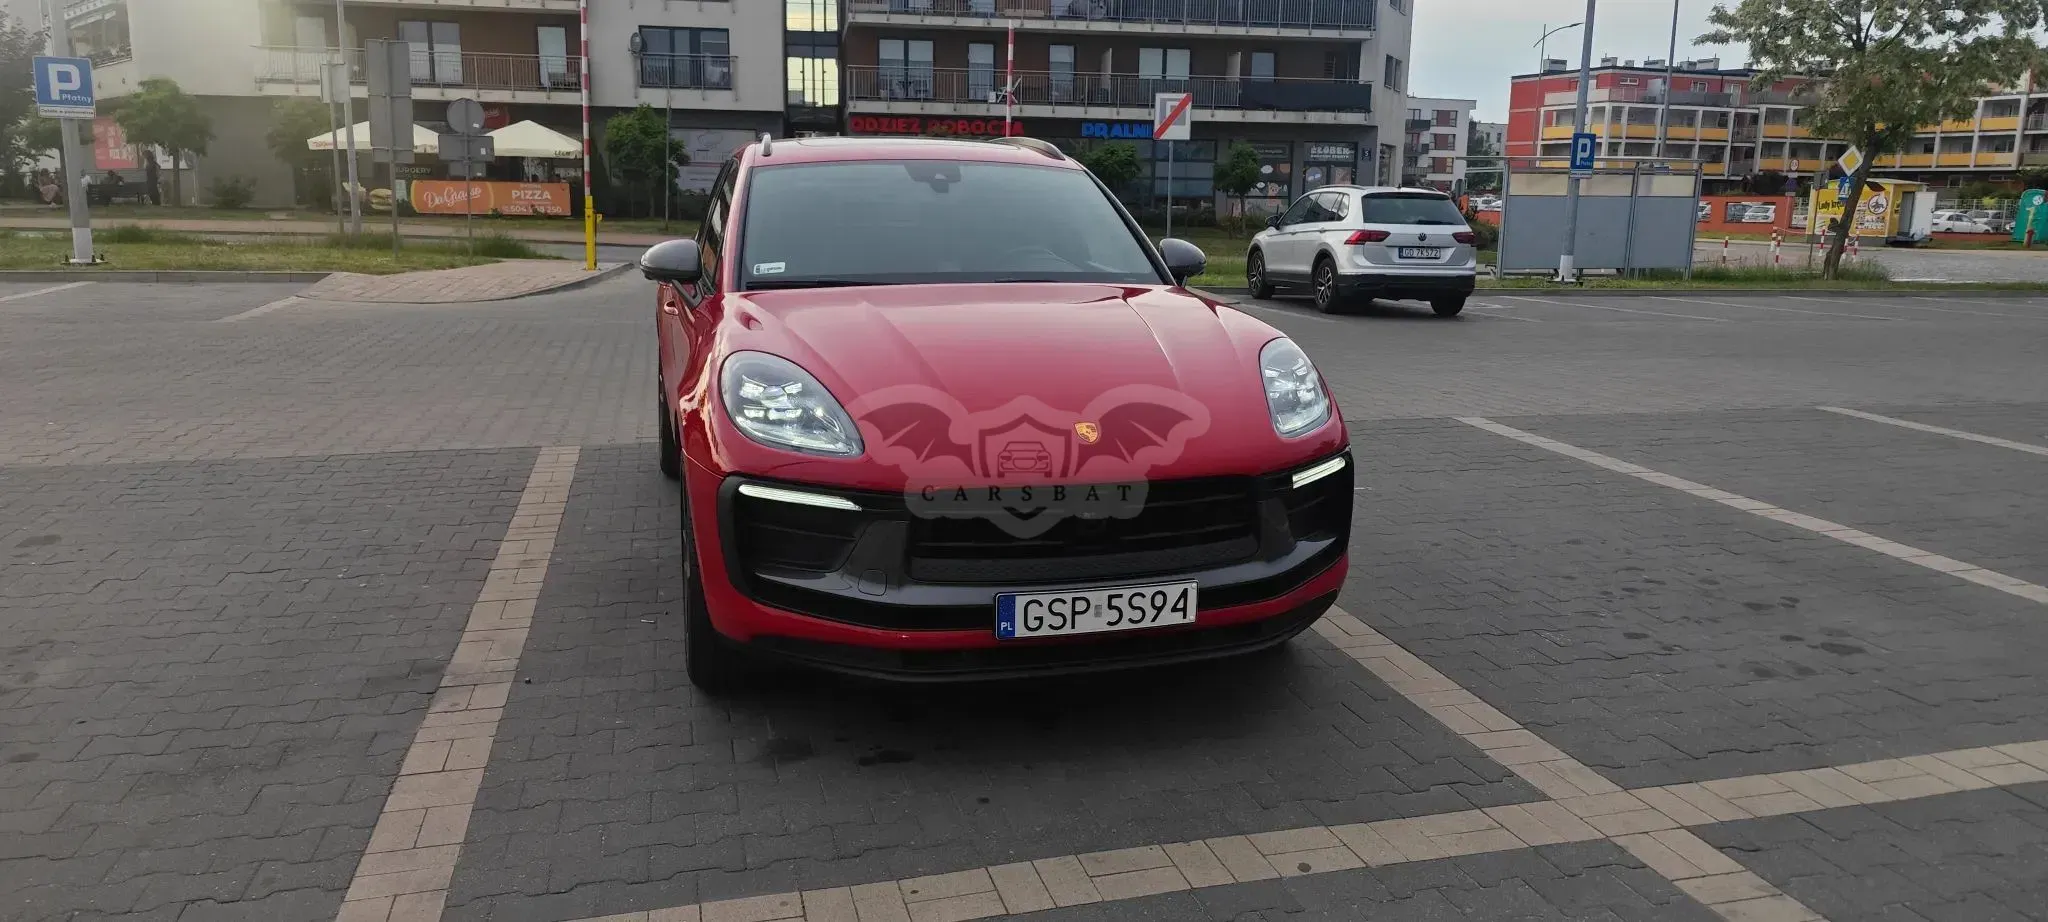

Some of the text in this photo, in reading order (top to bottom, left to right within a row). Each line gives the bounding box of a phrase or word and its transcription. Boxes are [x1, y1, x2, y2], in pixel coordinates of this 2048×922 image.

[48, 63, 81, 100] P
[1082, 122, 1154, 138] PRALNI
[1576, 138, 1591, 166] P
[511, 190, 552, 200] PIZZA
[1023, 588, 1189, 632] GSP 5S94
[1001, 621, 1013, 631] PL
